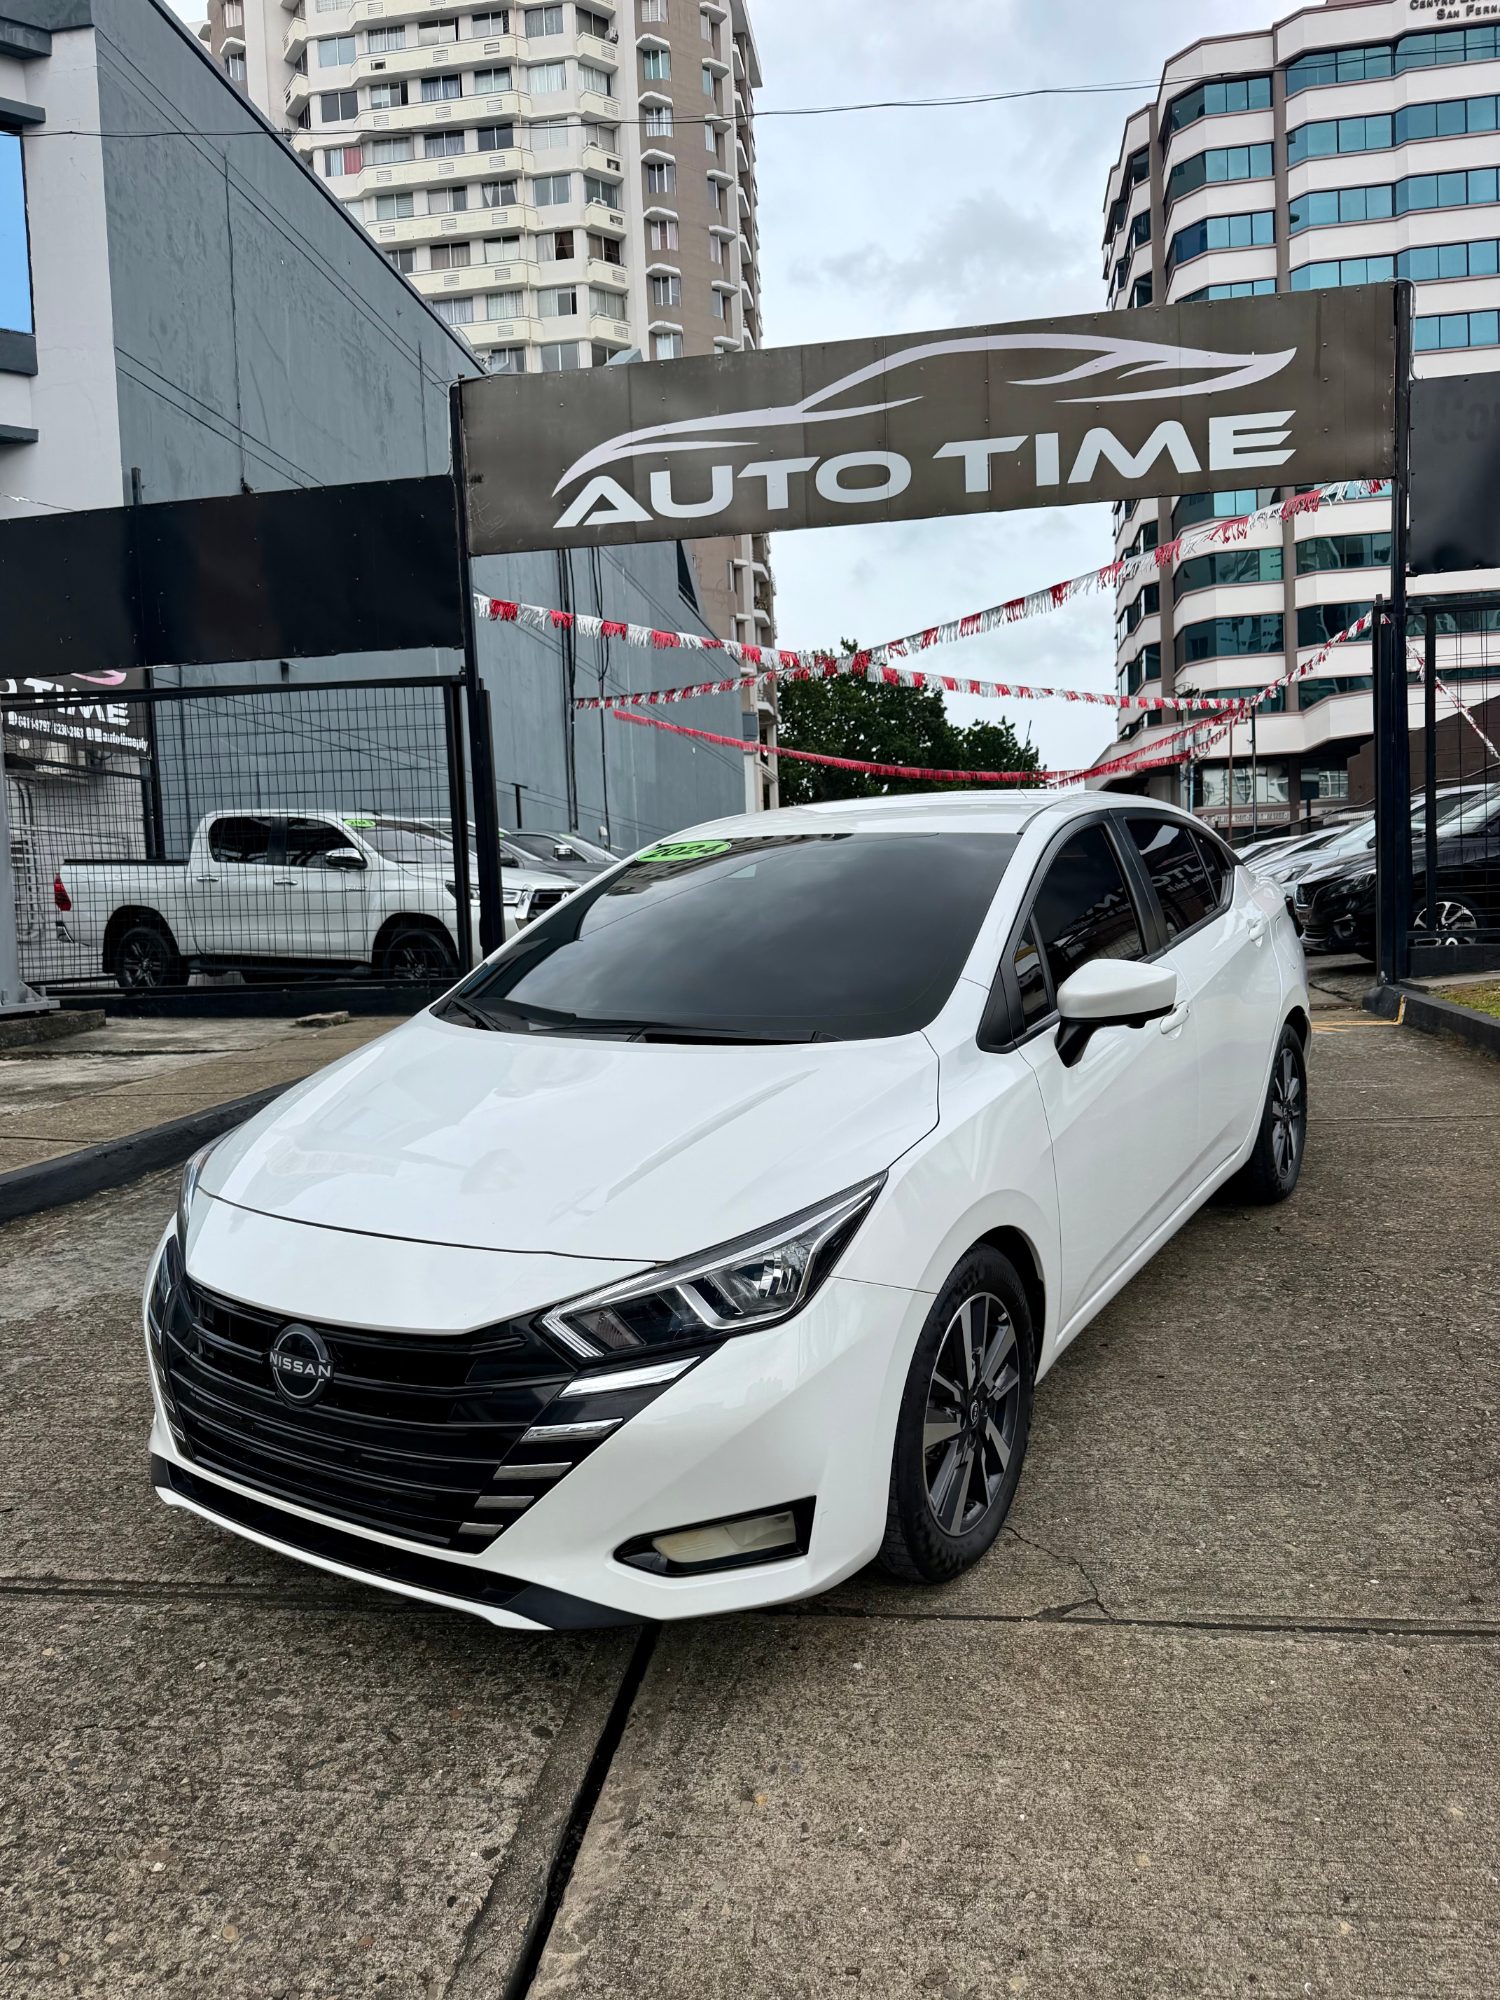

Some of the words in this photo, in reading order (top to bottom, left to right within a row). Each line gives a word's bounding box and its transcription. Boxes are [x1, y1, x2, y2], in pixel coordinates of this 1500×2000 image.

[1436, 7, 1460, 20] SAN
[1466, 4, 1500, 17] FERN
[552, 450, 912, 529] AUTO
[932, 409, 1297, 494] TIME
[269, 1351, 332, 1378] NISSAN
